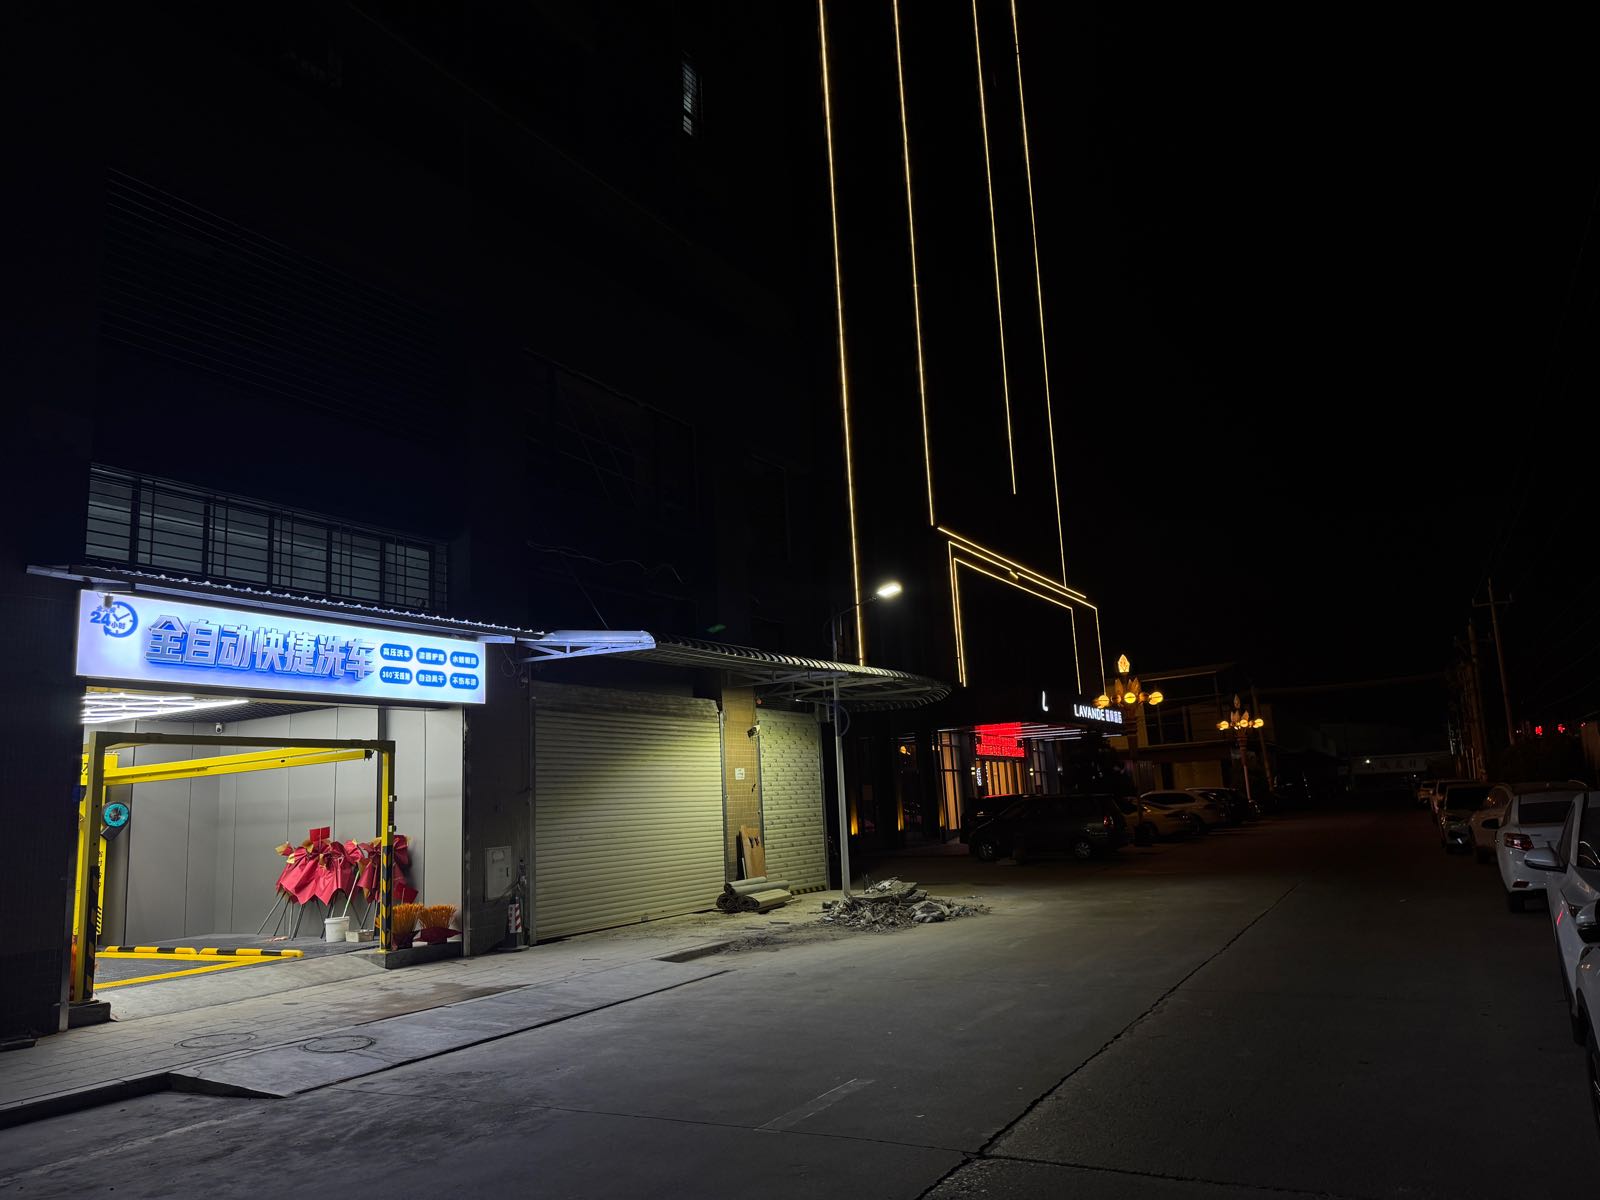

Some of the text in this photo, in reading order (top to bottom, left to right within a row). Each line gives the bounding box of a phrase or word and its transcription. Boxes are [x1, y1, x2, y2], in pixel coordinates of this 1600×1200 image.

[145, 615, 376, 680] 全自动快捷洗车
[383, 648, 411, 658] 高压洗车
[418, 674, 445, 684] 自动风干
[1073, 704, 1105, 721] LAVANDE
